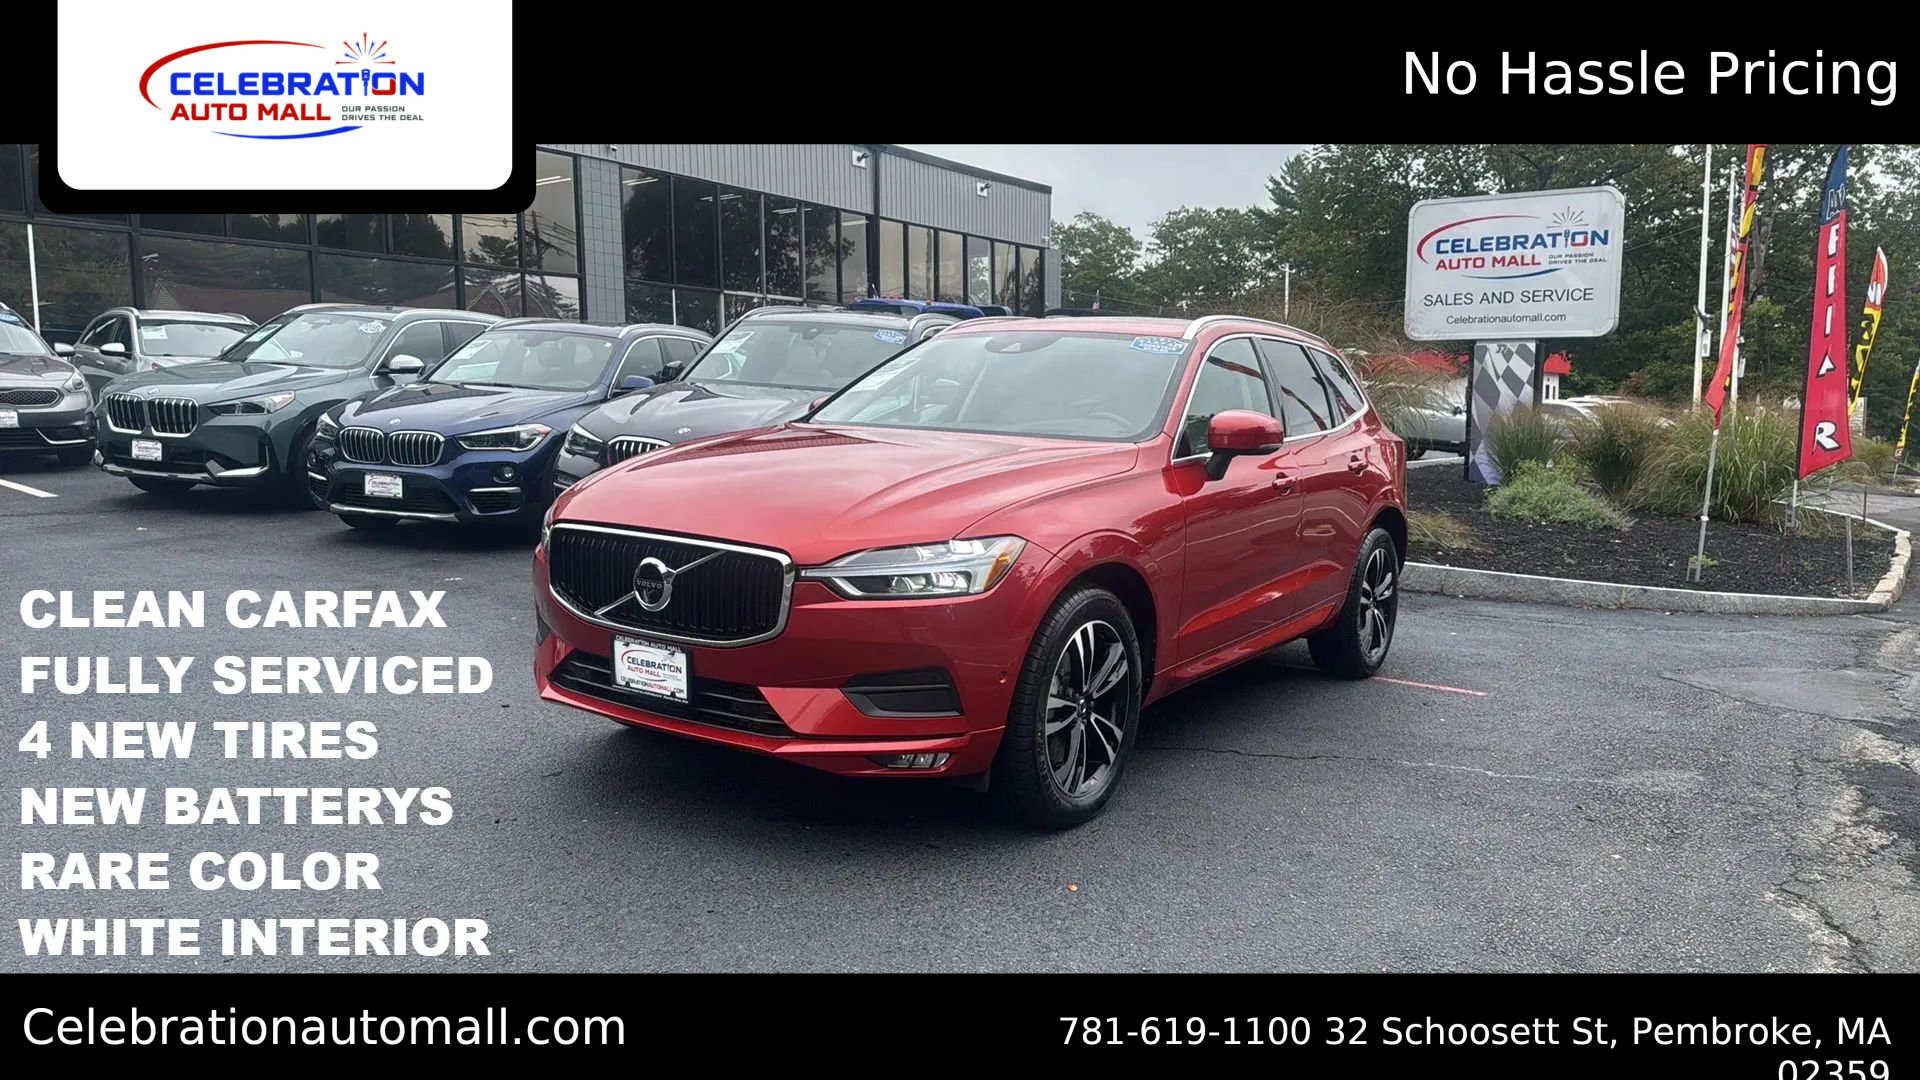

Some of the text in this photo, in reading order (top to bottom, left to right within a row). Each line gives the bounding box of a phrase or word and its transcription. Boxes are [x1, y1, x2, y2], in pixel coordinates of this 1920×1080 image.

[1436, 230, 1608, 254] CELEBRATION
[1435, 255, 1542, 271] AUTO MALL
[1423, 287, 1594, 307] SALES AND SERVICE
[1446, 312, 1567, 326] Celebrationautomall.com
[637, 579, 662, 589] VOLVO
[650, 642, 666, 650] AUTO
[627, 656, 682, 674] CELEBRATION
[627, 666, 661, 677] AUTO MALL
